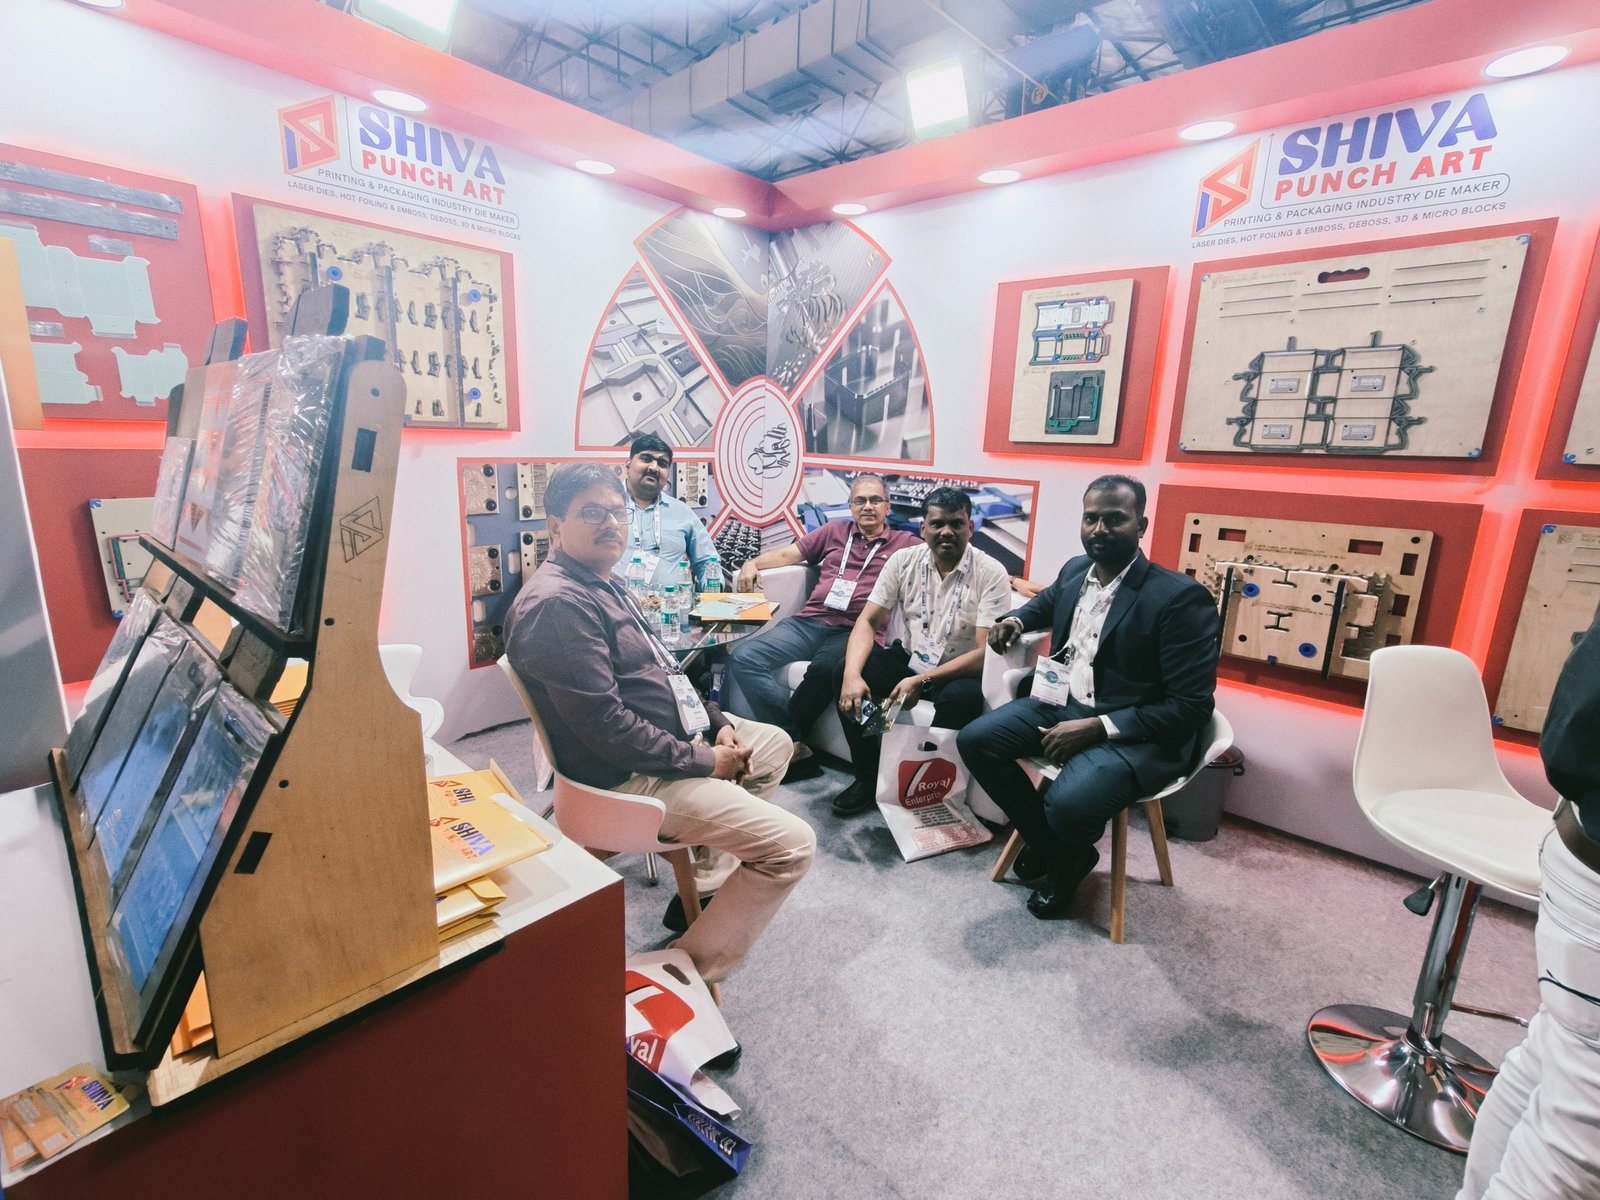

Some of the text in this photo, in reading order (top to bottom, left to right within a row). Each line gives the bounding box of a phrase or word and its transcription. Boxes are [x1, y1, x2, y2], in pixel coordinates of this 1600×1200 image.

[358, 106, 506, 185] SHIVA
[1278, 93, 1498, 176] SHIVA
[317, 168, 516, 225] PRINTING & PACKAGING INDUSTRY DIE MAKER
[361, 149, 506, 206] PUNCH ART
[1274, 145, 1493, 201] PUNCH ART
[287, 180, 314, 194] LASER
[316, 187, 338, 200] DIES,
[340, 191, 357, 203] HOT
[358, 195, 388, 210] FOILING
[390, 203, 396, 212] &
[397, 205, 429, 221] EMBOSS,
[460, 220, 470, 229] 3D
[471, 222, 476, 230] &
[477, 224, 498, 235] MICRO
[498, 229, 522, 241] BLOCKS
[1192, 201, 1507, 249] LASER DIES, HOT FOILING & EMBOSS, DEBOSS, 3D & MICRO BLOCKS
[1223, 180, 1501, 228] PRINTING & PACKAGING INDUSTRY DIE MAKER
[453, 788, 476, 804] SHI
[918, 777, 951, 792] Royal
[450, 822, 495, 856] SHIVA
[627, 1035, 659, 1065] yal
[81, 1080, 115, 1111] SHIVA
